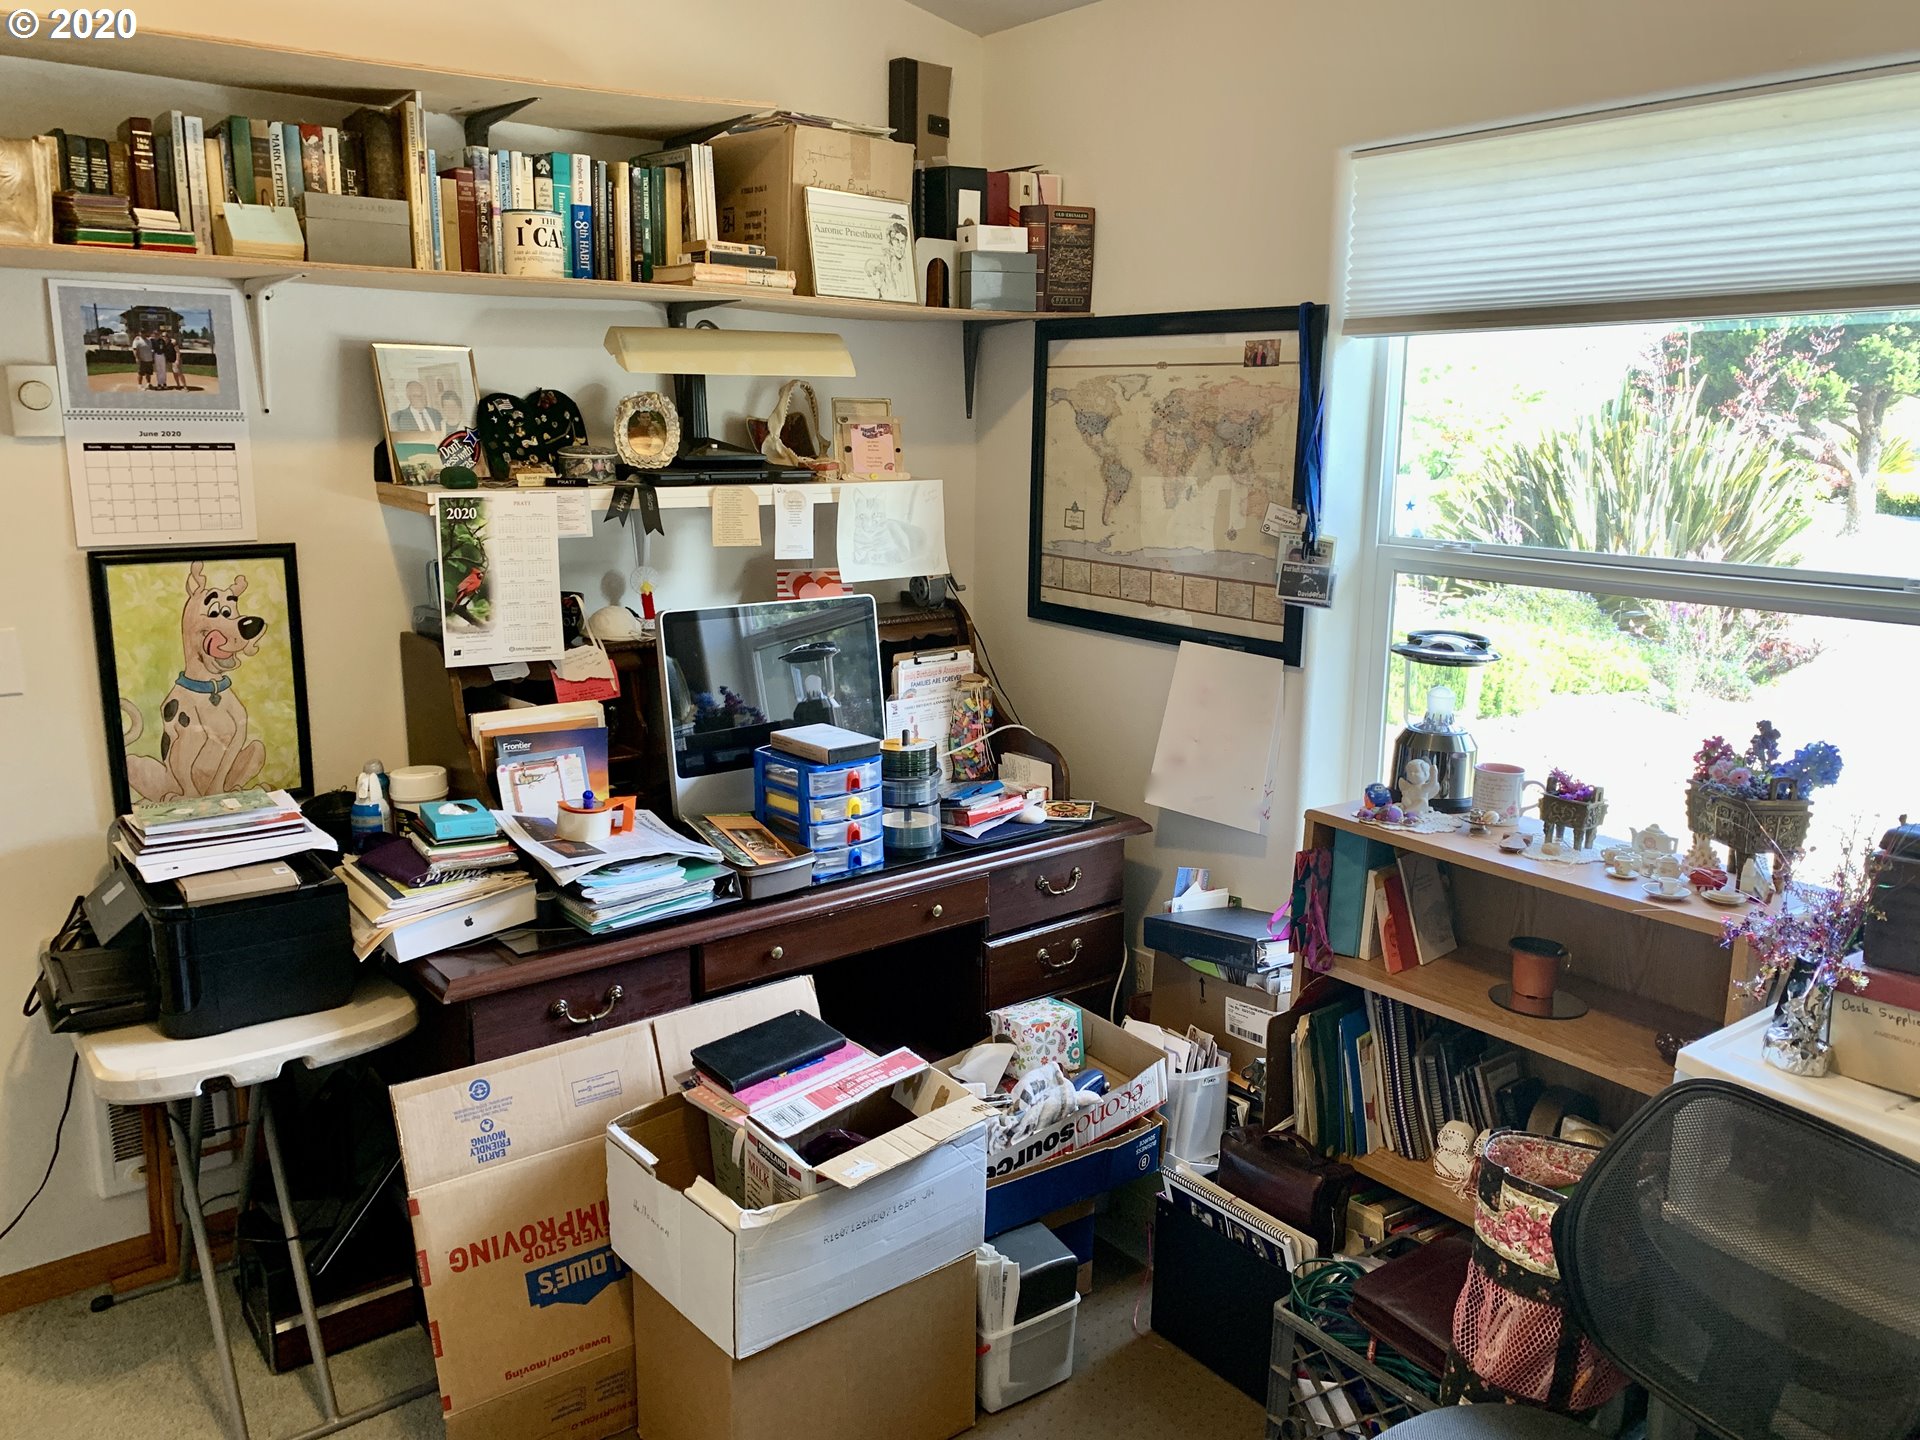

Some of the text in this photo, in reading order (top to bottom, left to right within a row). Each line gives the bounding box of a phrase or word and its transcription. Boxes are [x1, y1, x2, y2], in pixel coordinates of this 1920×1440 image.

[272, 134, 281, 163] MARK
[516, 227, 525, 246] I
[574, 220, 590, 239] 8th
[814, 224, 883, 240] Aaronic Priesthood
[579, 240, 591, 270] HABIT
[457, 445, 474, 460] with
[446, 507, 477, 520] 2020
[910, 679, 931, 687] FAMILIES
[502, 741, 532, 751] Frontier
[1842, 998, 1920, 1029] Desk Supplie
[469, 1137, 511, 1157] FRIENDLY
[471, 1130, 506, 1147] MOVING
[1136, 1140, 1157, 1155] BUSINESS
[478, 1147, 506, 1164] EARTH
[758, 1142, 786, 1169] KIRKLAND
[749, 1160, 770, 1190] MILK
[449, 1200, 608, 1273] IMPROVING
[522, 1225, 608, 1264] EVER STOP
[537, 1249, 622, 1296] LOWE'S
[504, 1334, 612, 1382] lowes.com/moving
